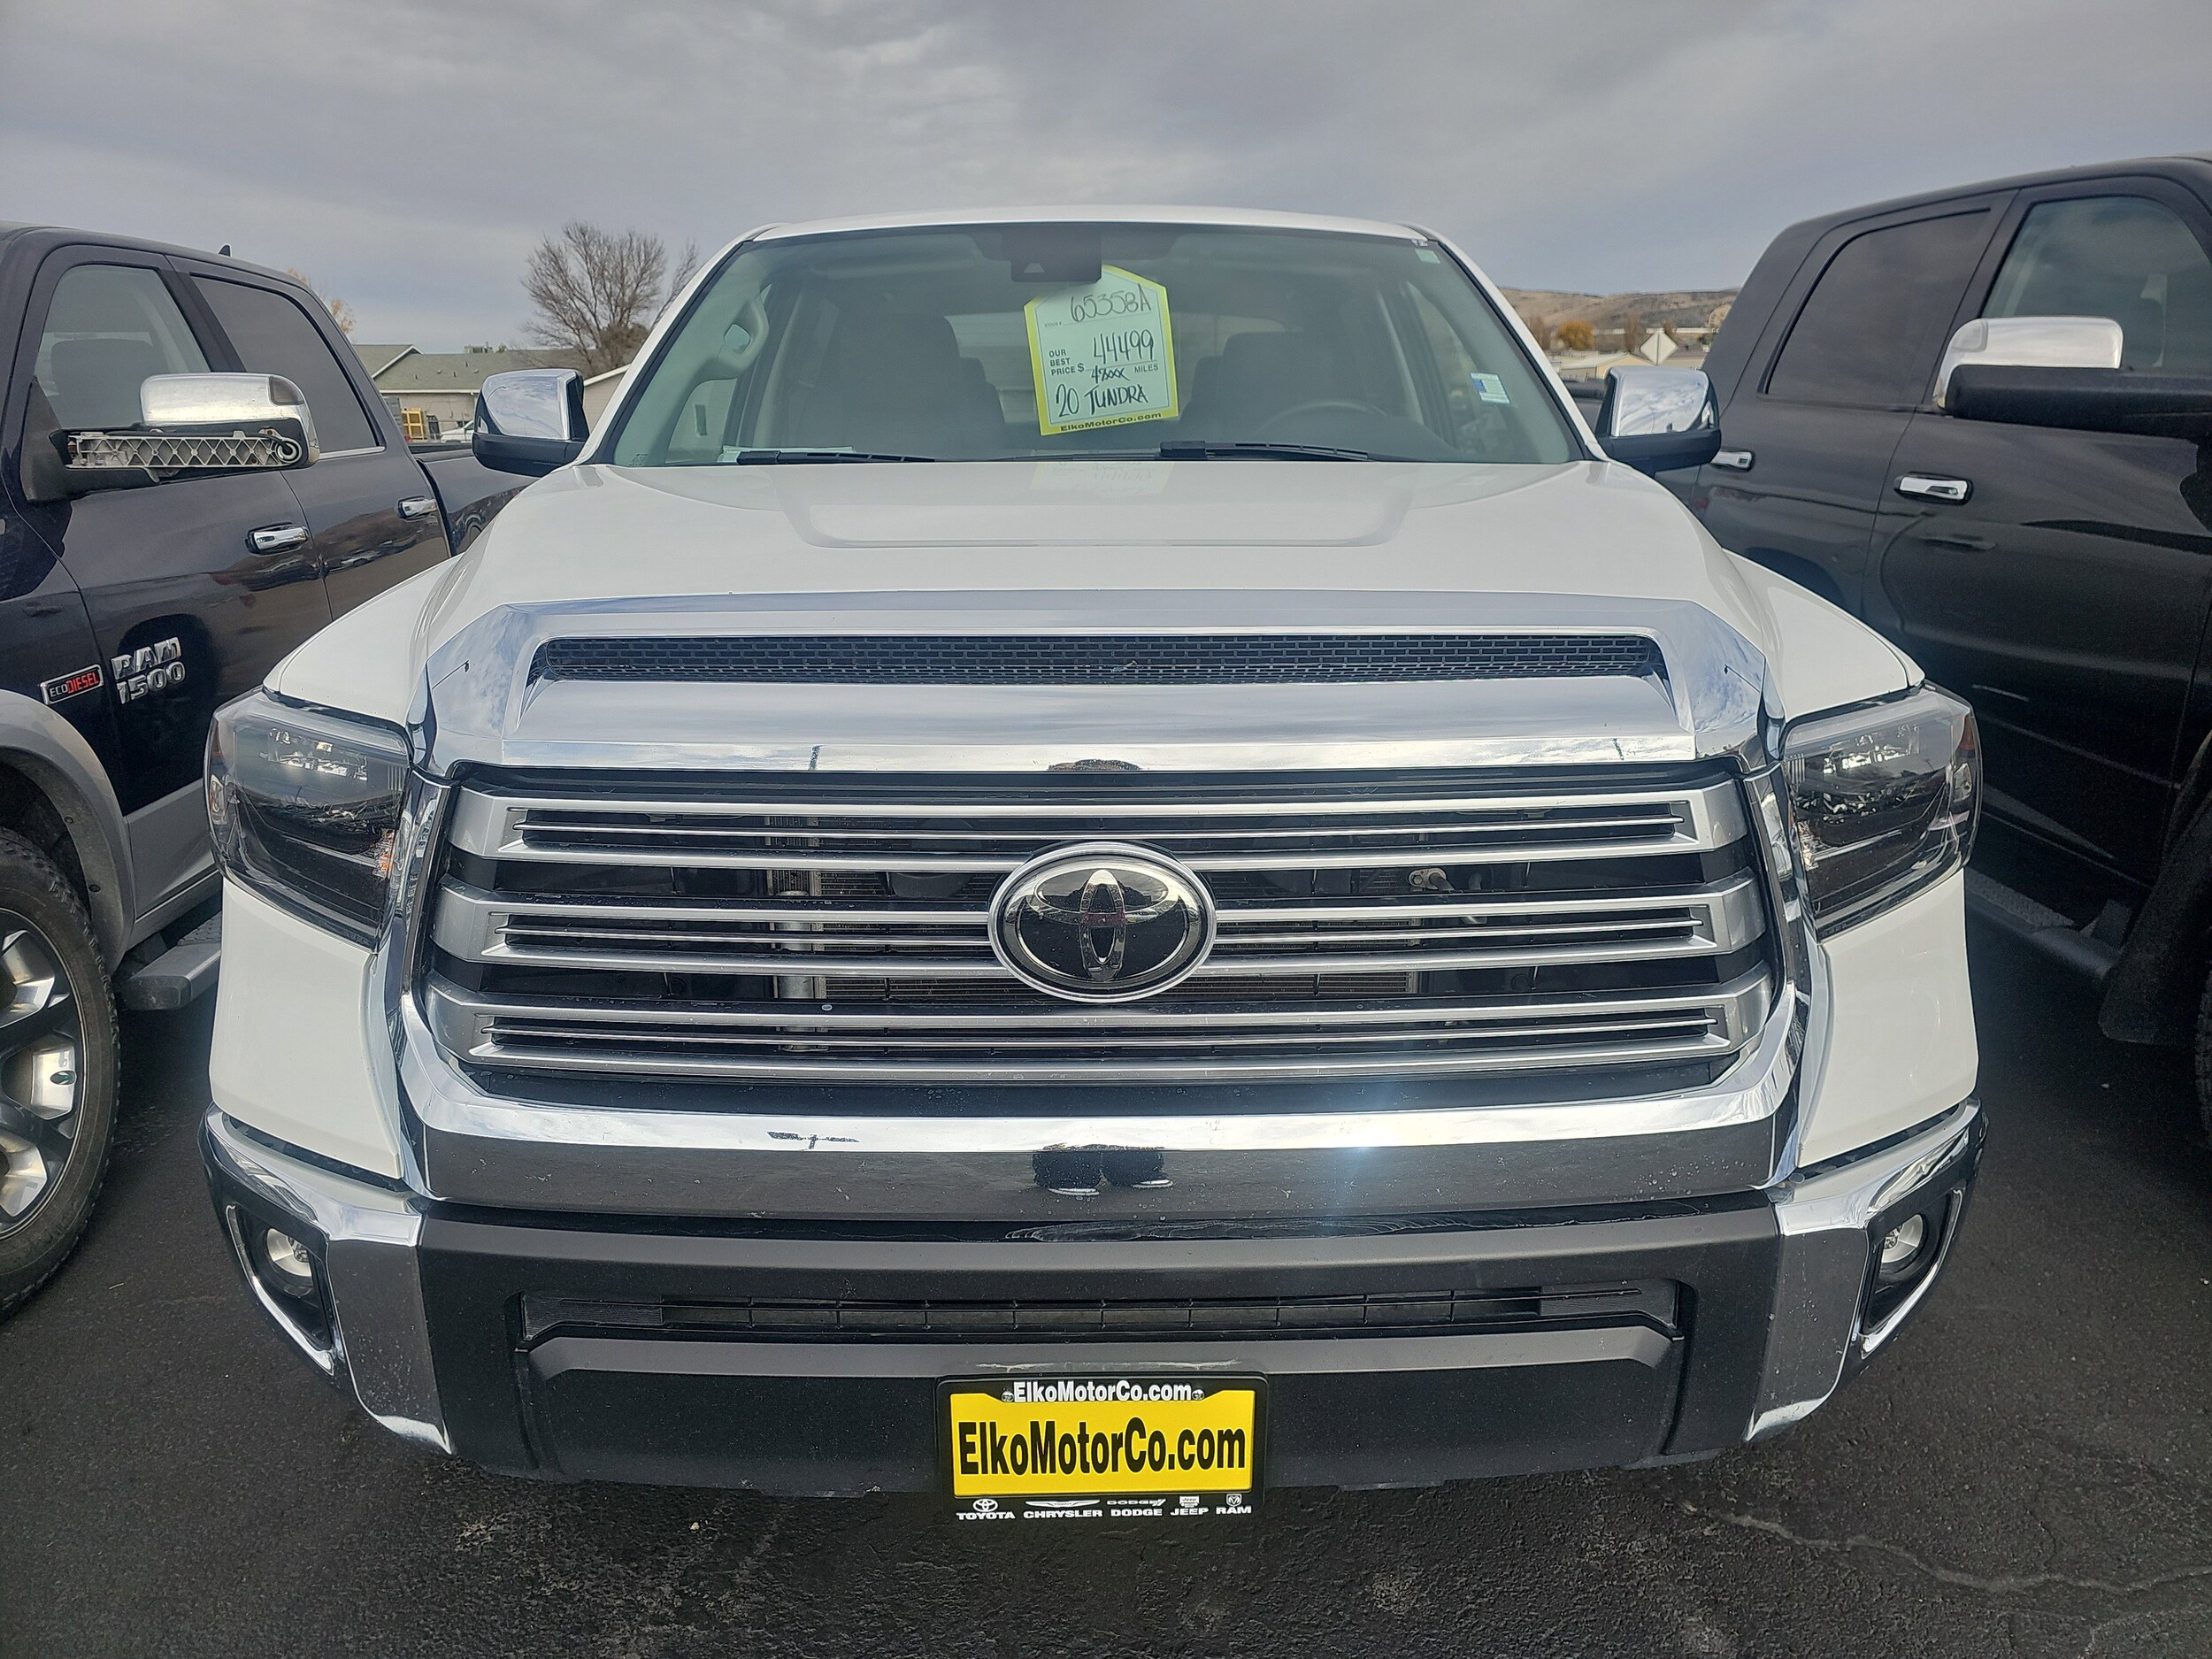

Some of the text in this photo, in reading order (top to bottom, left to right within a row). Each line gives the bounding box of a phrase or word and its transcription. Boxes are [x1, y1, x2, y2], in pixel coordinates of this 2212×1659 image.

[1071, 283, 1152, 322] 65358A
[1048, 349, 1066, 357] OUR
[1093, 329, 1154, 365] 44499
[1049, 357, 1071, 367] BEST
[1051, 363, 1085, 376] PRICE $
[1134, 364, 1159, 373] MILES
[1056, 383, 1148, 418] 20 TUNDRA
[1060, 411, 1162, 432] ElkoMotorCo.com
[111, 636, 182, 680] RAM
[49, 671, 99, 697] ECODIESEL
[116, 661, 186, 705] 1500
[1013, 1380, 1192, 1403] ElkoMotorCo.com
[957, 1417, 1246, 1476] ElkoMotorCo.com
[956, 1505, 1252, 1520] TOYOTA CHRYSLER DODGE JEEP RAM
